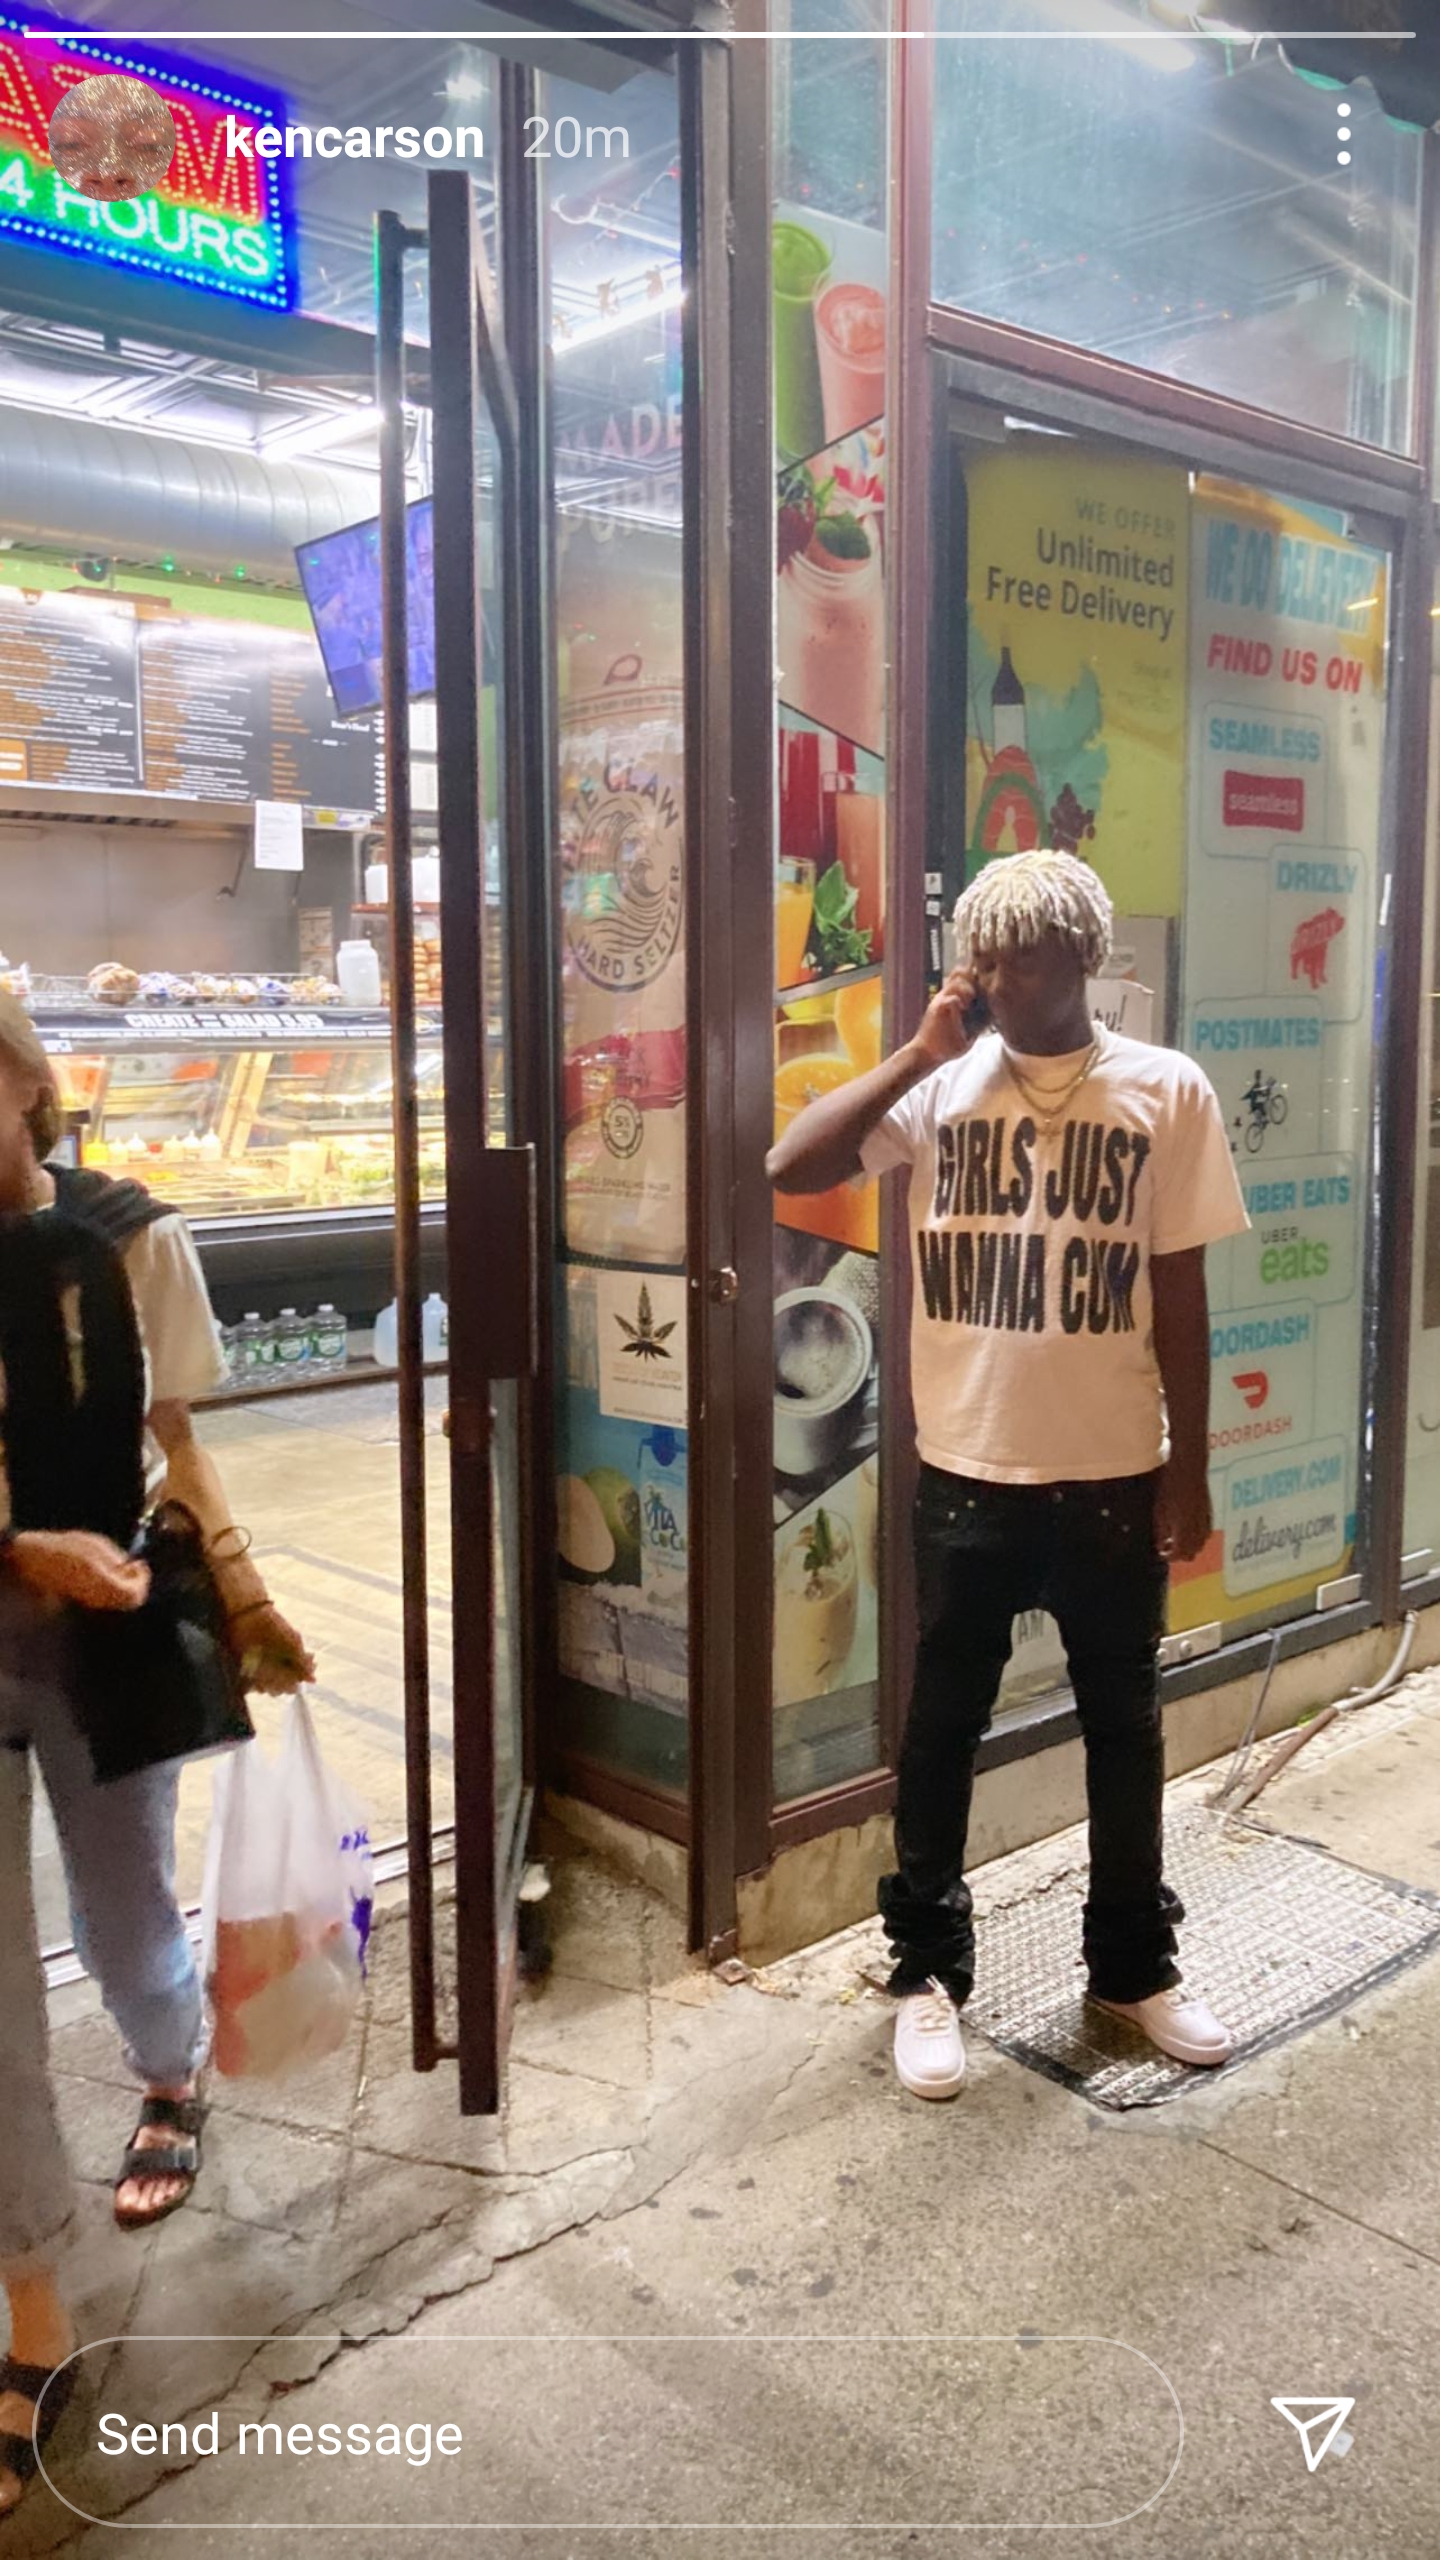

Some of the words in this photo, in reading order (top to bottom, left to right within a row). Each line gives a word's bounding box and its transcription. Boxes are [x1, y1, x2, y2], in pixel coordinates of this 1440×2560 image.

[53, 170, 270, 277] HOURS
[1075, 498, 1107, 525] WE
[1036, 526, 1175, 588] Unlimited
[985, 565, 1052, 612] Free
[1060, 579, 1174, 642] Delivery
[1207, 634, 1273, 676] FIND
[1282, 649, 1318, 685] US
[1326, 656, 1364, 693] ON
[1208, 717, 1321, 763] SEAMLESS
[1275, 860, 1358, 893] DRIZLY
[577, 935, 626, 980] HARD
[633, 863, 681, 976] SELTZER
[1196, 1018, 1320, 1050] POSTMATES
[934, 1117, 1036, 1218] GIRLS
[1046, 1120, 1151, 1226] JUST
[1304, 1176, 1350, 1208] EATS
[1261, 1226, 1299, 1245] UBER
[917, 1231, 1045, 1333] WANNA
[1260, 1238, 1329, 1284] eats
[1210, 1314, 1310, 1358] OORDASH
[1207, 1416, 1292, 1450] DOORDASH
[1231, 1457, 1341, 1510] DELIVERY.COM
[1232, 1514, 1337, 1563] delivery.com
